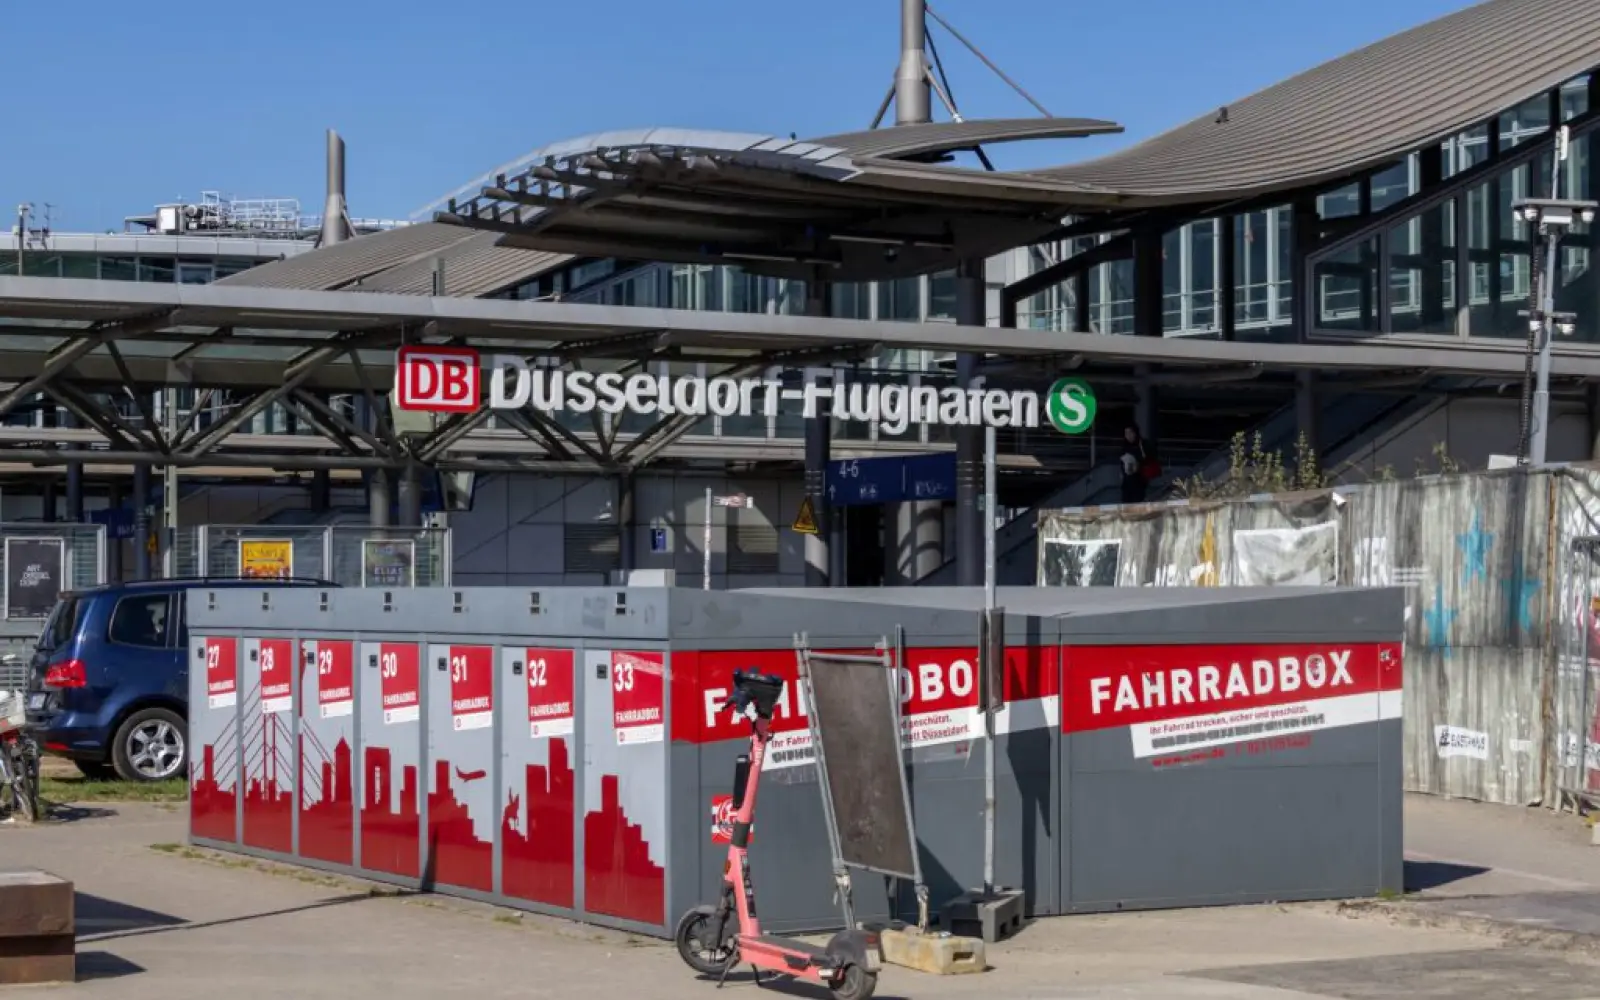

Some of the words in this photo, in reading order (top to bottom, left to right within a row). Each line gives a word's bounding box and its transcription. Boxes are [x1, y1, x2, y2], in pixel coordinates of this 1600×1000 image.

[409, 358, 470, 400] DB
[490, 354, 1039, 435] Düsseldorf-Flughafen
[1058, 384, 1088, 426] S
[208, 645, 220, 668] 27
[262, 647, 274, 671] 28
[319, 649, 333, 674] 29
[382, 652, 397, 678] 30
[452, 655, 467, 683] 31
[528, 660, 547, 687] 32
[614, 663, 634, 691] 33
[1090, 650, 1353, 714] FAHRRADBOX
[530, 702, 571, 717] FAHRRADBOX
[616, 707, 660, 723] FAHRRADBOX
[1164, 720, 1195, 734] Fahrrad
[1254, 710, 1270, 720] und
[772, 740, 784, 751] Ihr
